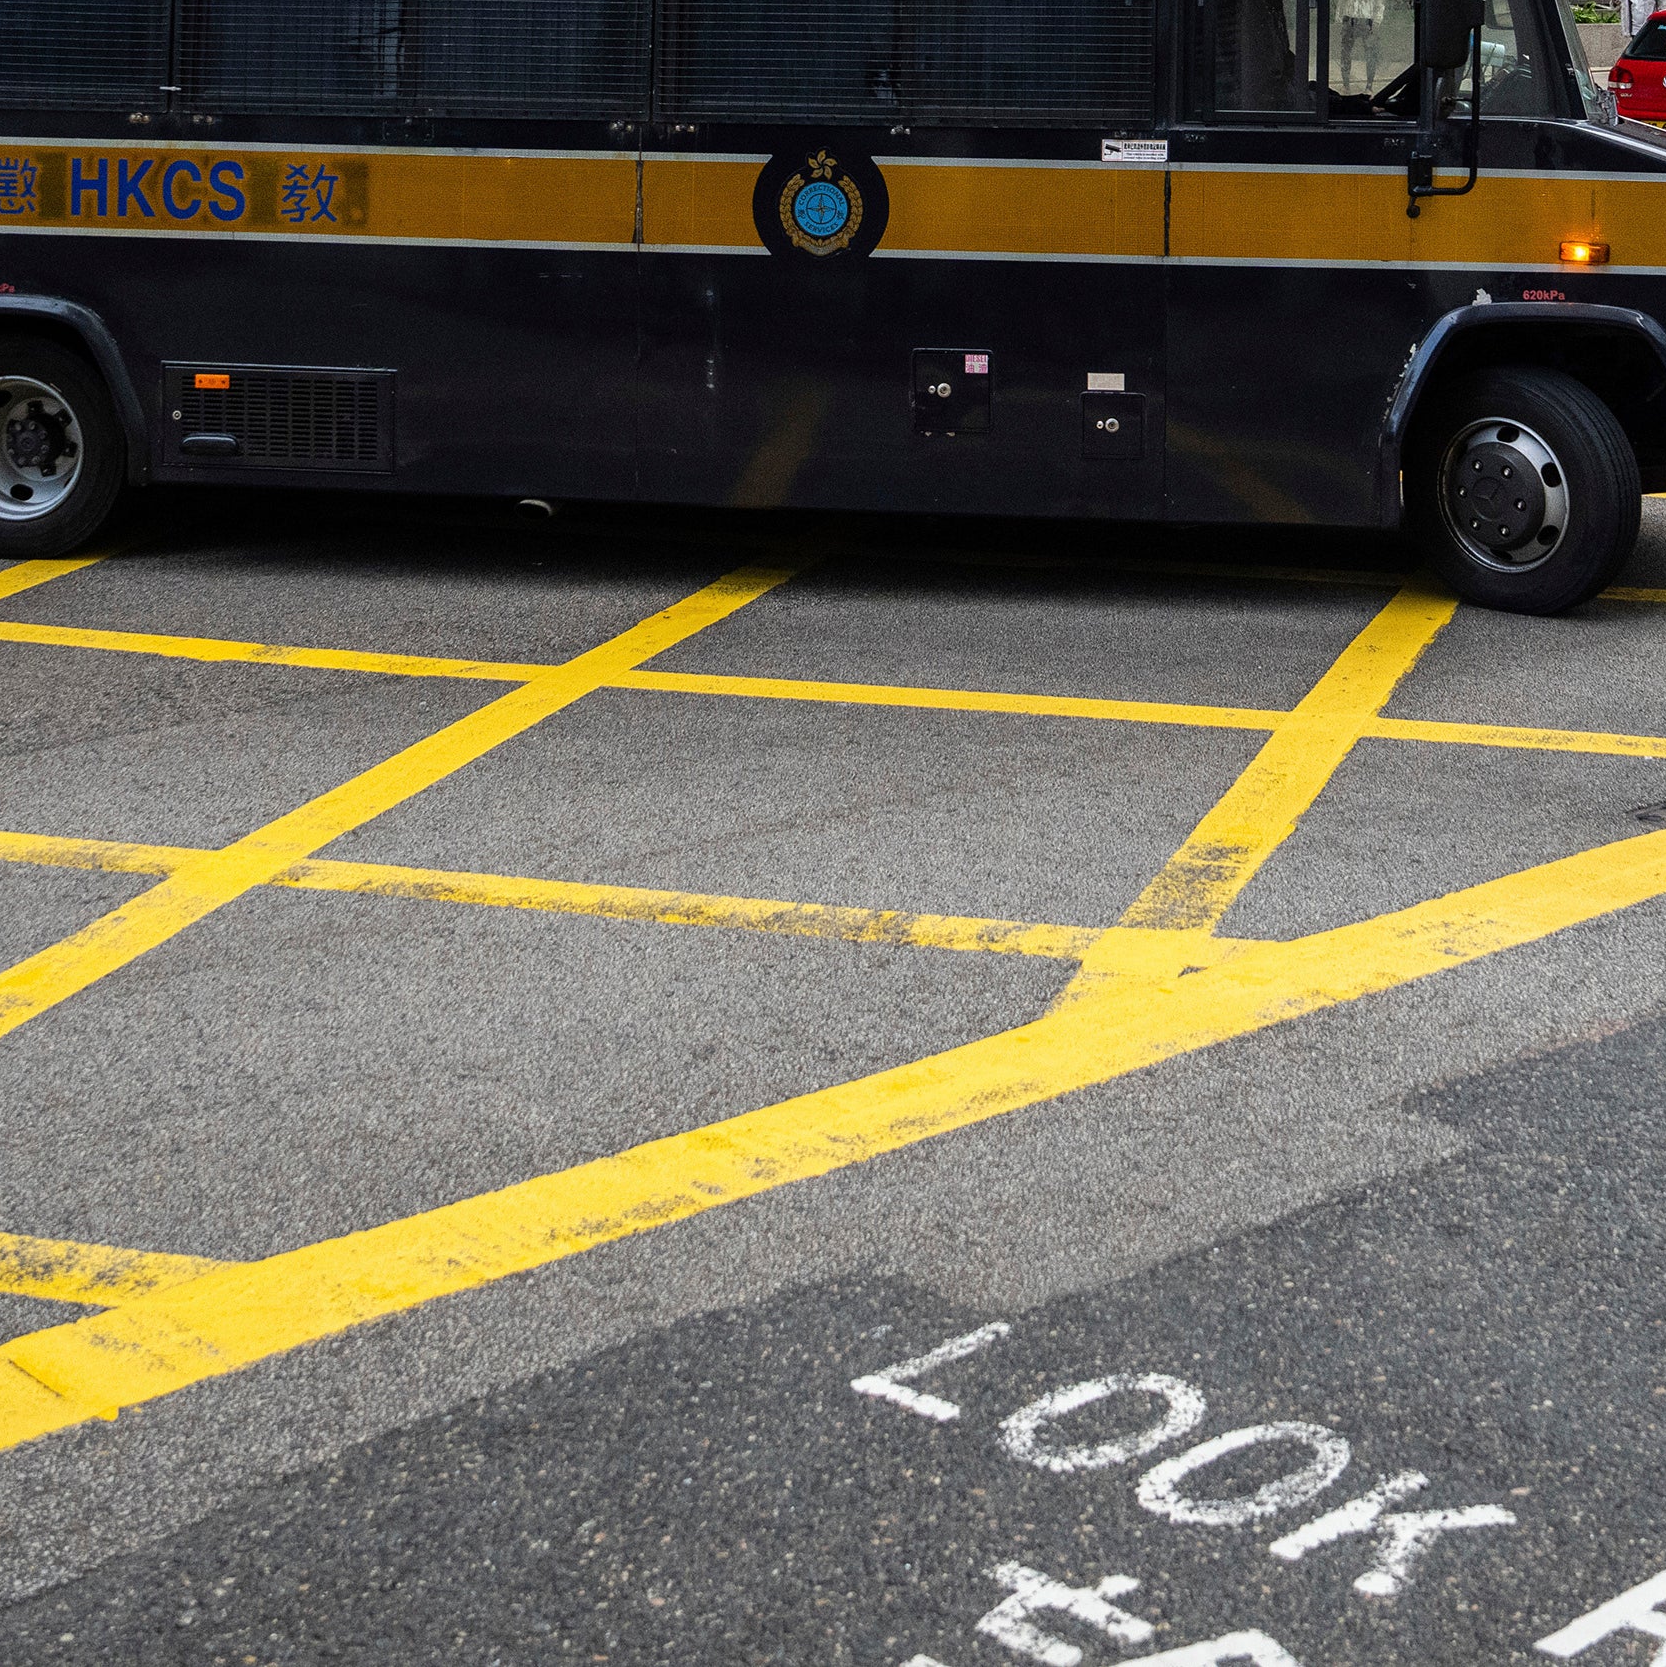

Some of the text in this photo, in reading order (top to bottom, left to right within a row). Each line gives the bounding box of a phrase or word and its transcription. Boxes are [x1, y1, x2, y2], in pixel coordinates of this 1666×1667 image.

[70, 157, 246, 222] HKCS
[280, 163, 340, 224] 教
[1522, 289, 1566, 301] 620kPa
[849, 1319, 1519, 1598] LOOK
